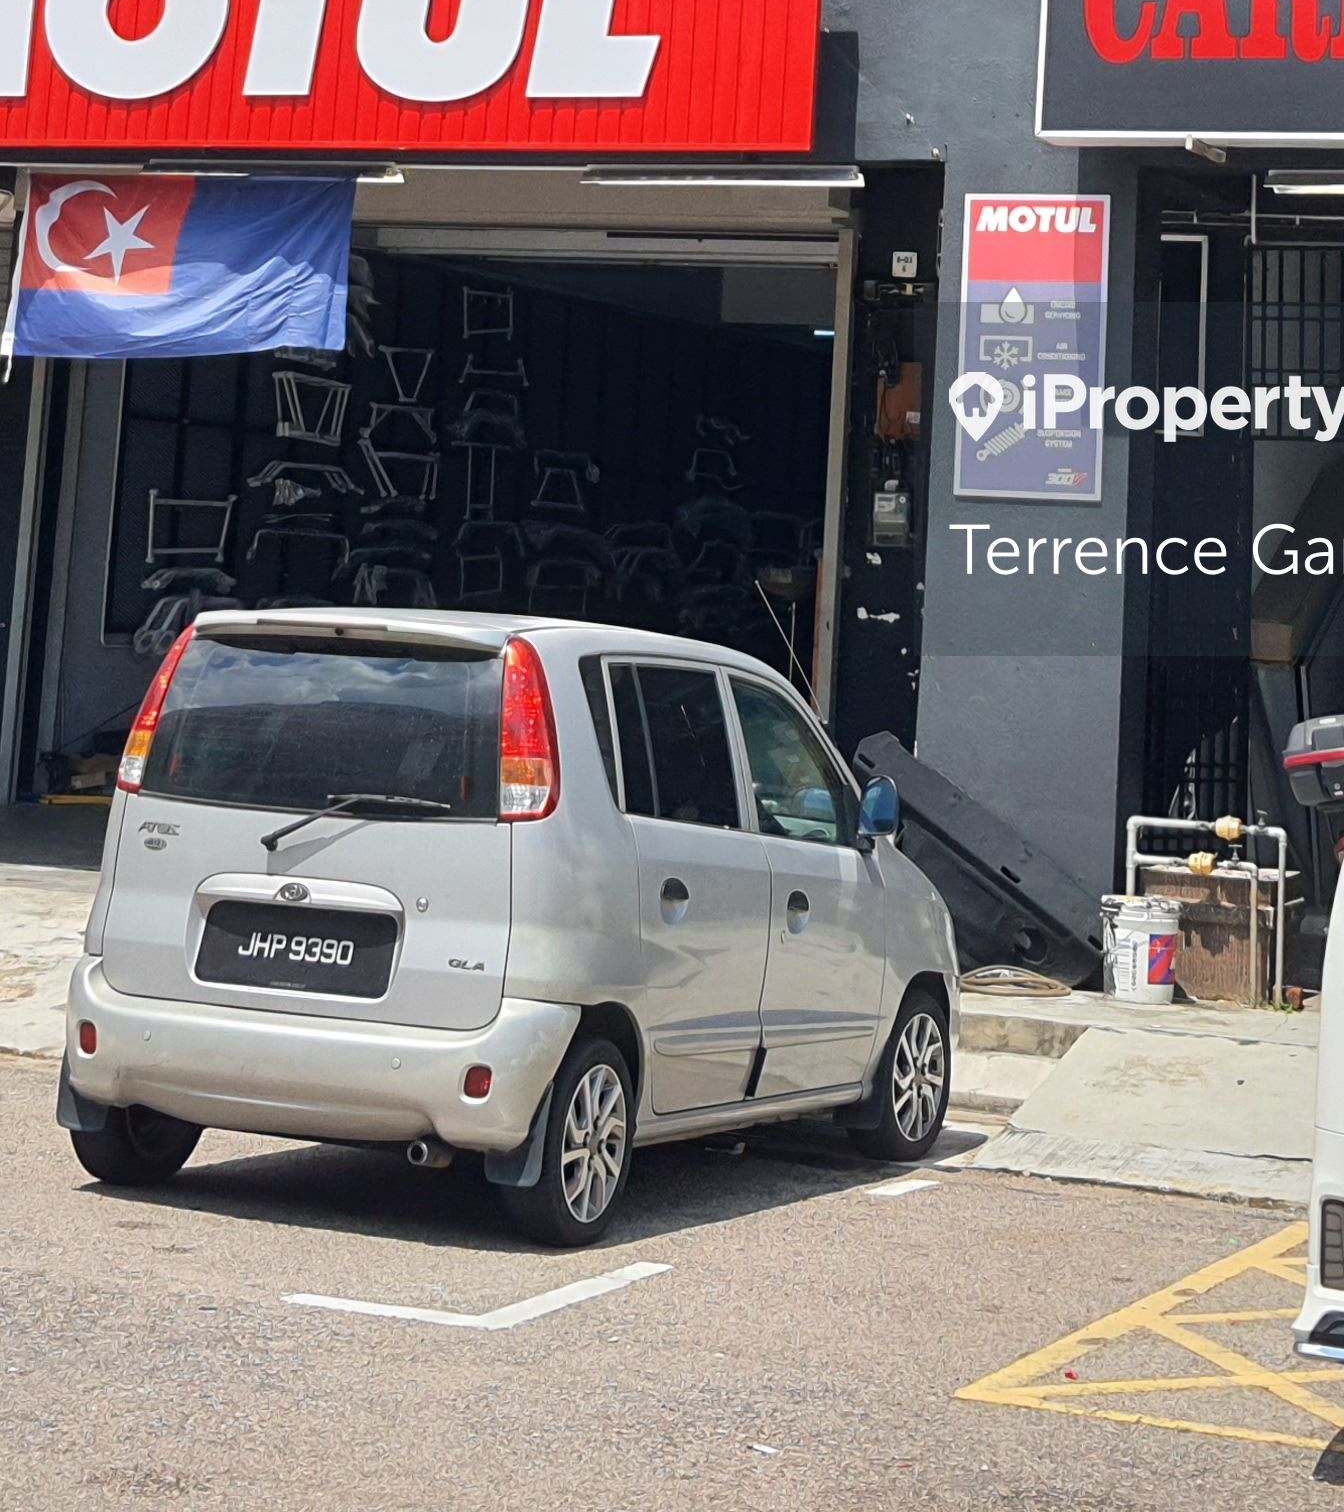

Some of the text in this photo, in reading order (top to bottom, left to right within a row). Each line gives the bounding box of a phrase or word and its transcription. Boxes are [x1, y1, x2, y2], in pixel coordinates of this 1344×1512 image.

[975, 205, 1097, 234] MOTUL
[237, 931, 355, 966] JHP 9390
